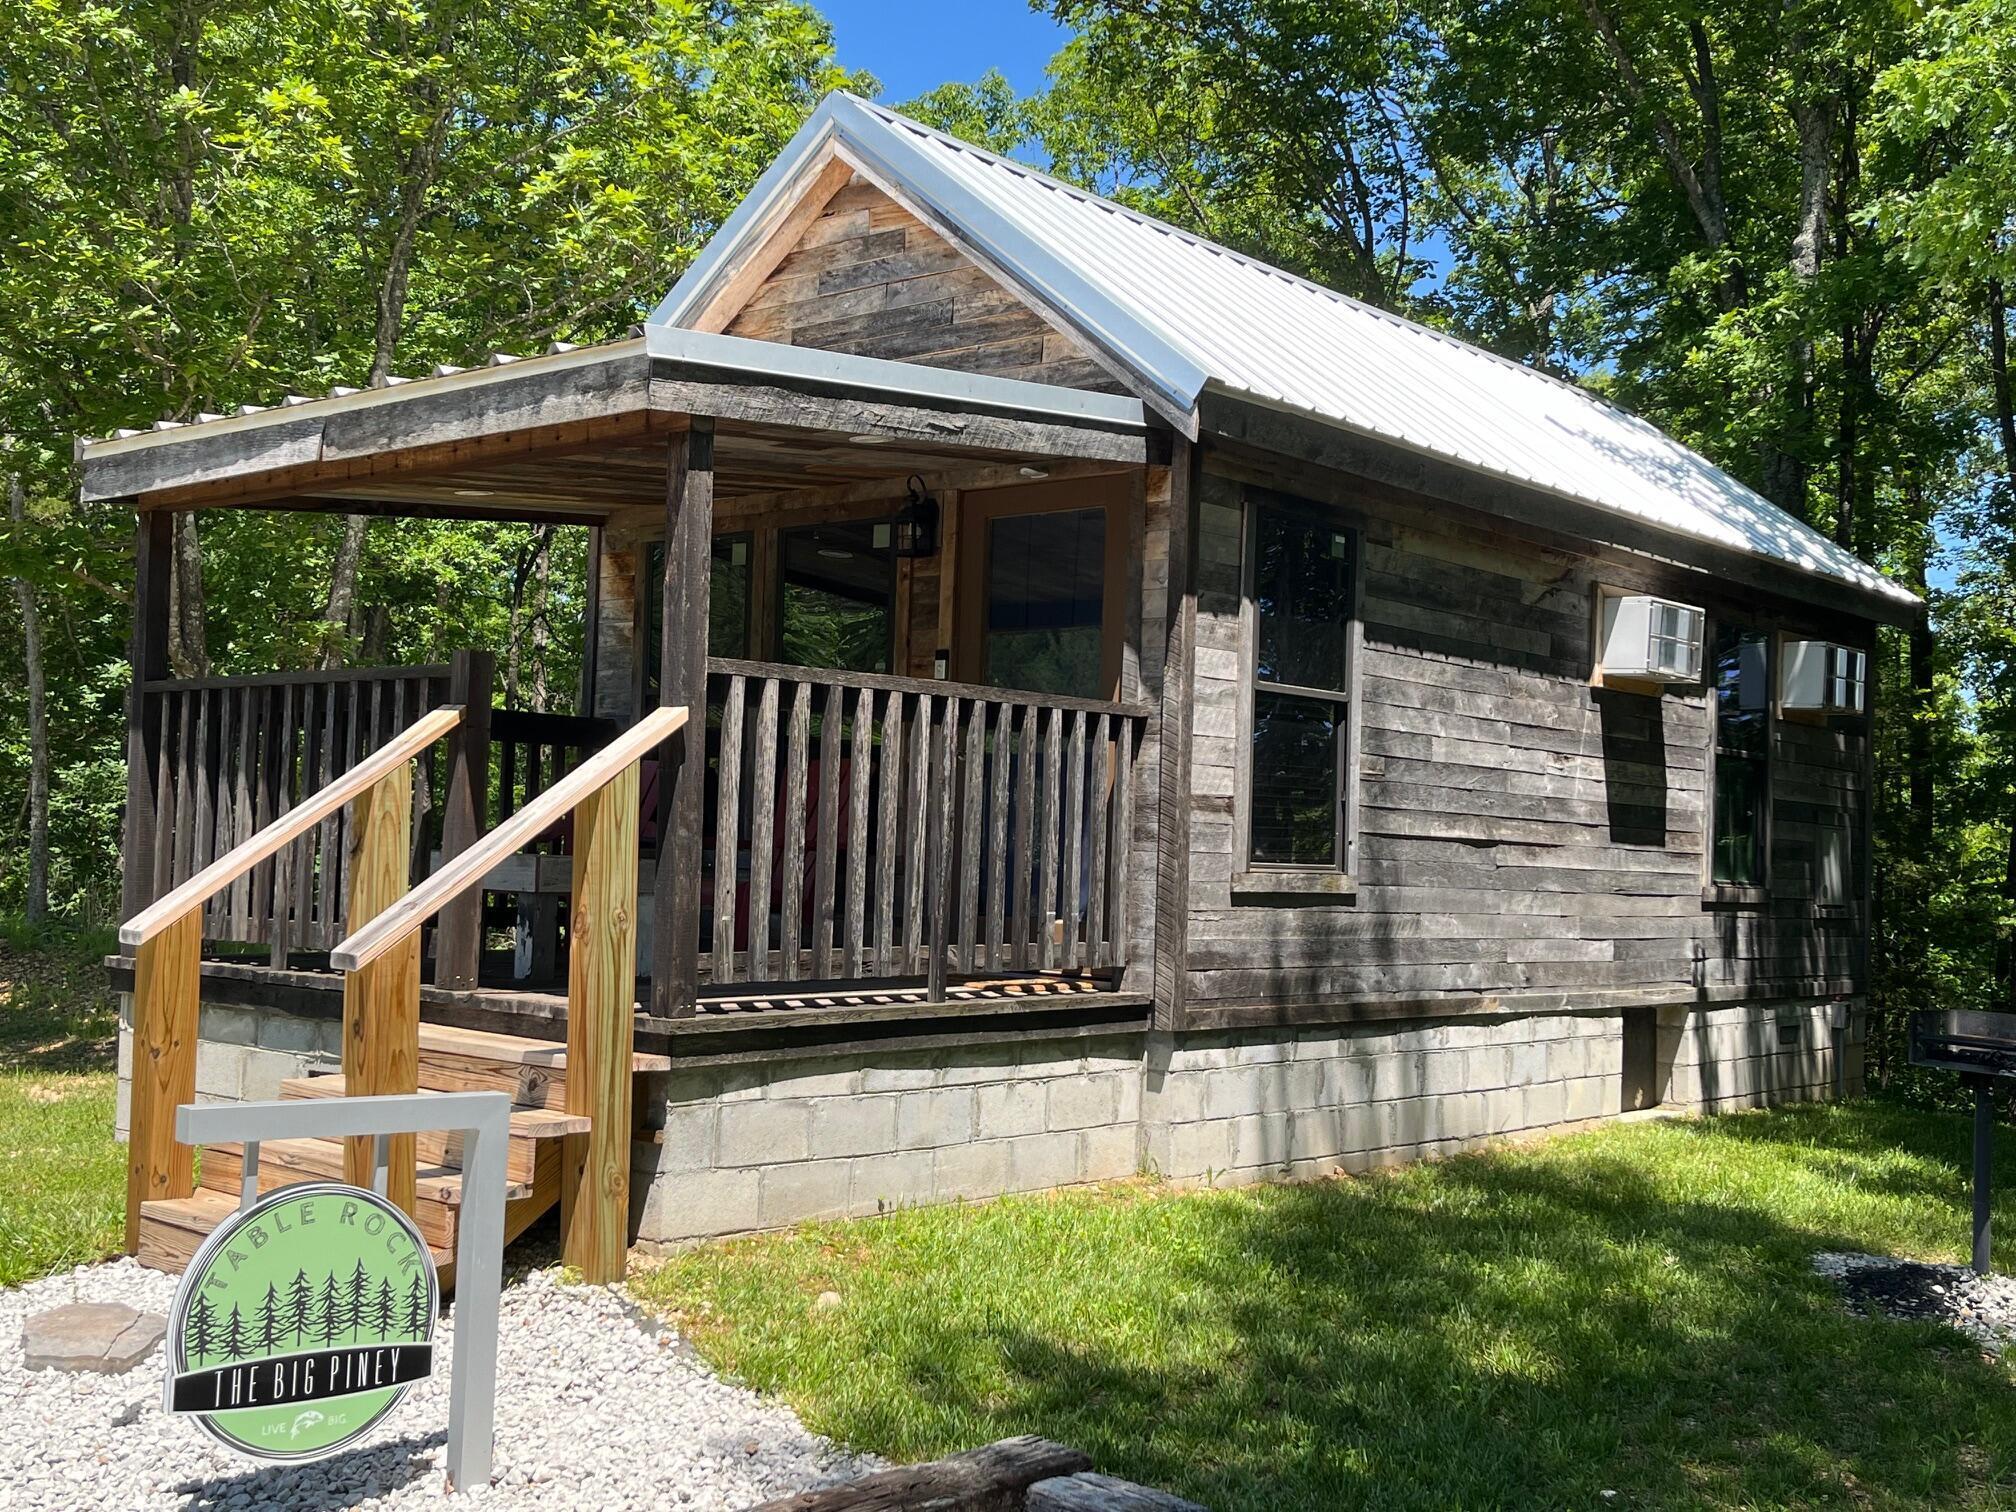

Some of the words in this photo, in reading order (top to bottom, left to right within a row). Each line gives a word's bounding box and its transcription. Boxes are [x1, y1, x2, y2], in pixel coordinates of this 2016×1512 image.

[205, 1201, 316, 1290] TABLE
[339, 1201, 421, 1276] ROCK
[215, 1365, 260, 1408] THE
[273, 1357, 315, 1399] BIG
[329, 1347, 400, 1392] PINEY
[261, 1422, 286, 1436] LIVE
[327, 1413, 347, 1426] BIG
